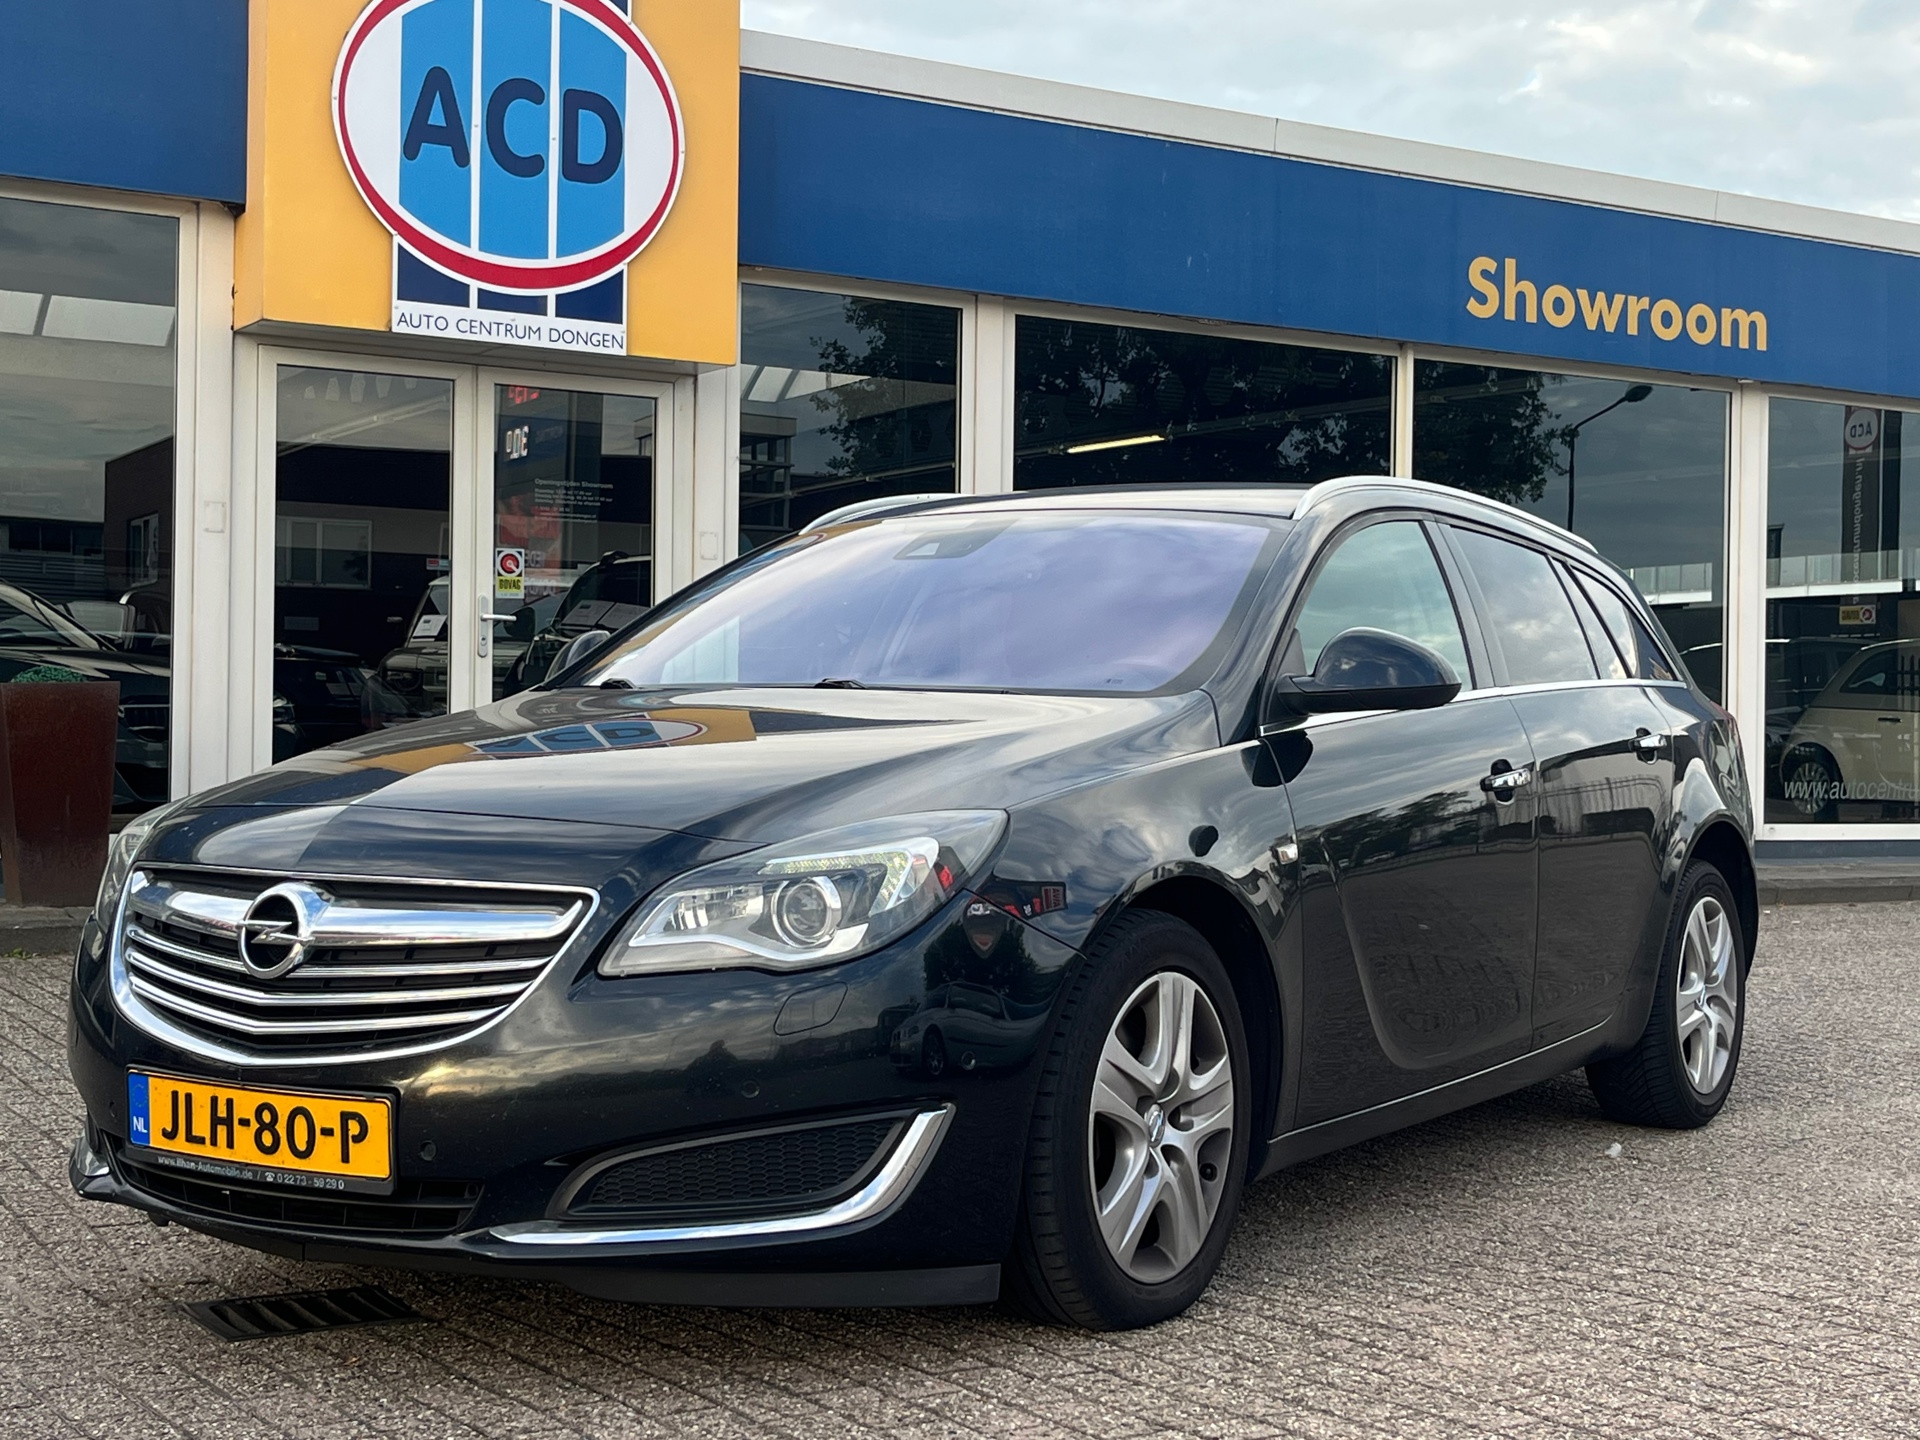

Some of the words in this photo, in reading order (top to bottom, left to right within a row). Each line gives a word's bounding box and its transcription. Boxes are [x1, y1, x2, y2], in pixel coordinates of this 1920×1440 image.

[403, 66, 624, 184] ACD
[396, 311, 449, 332] AUTO
[456, 317, 542, 342] CENTRUM
[548, 327, 624, 350] DONGEN
[1465, 256, 1768, 352] Showroom
[132, 1115, 148, 1134] NL
[161, 1090, 369, 1164] JLH-80-P
